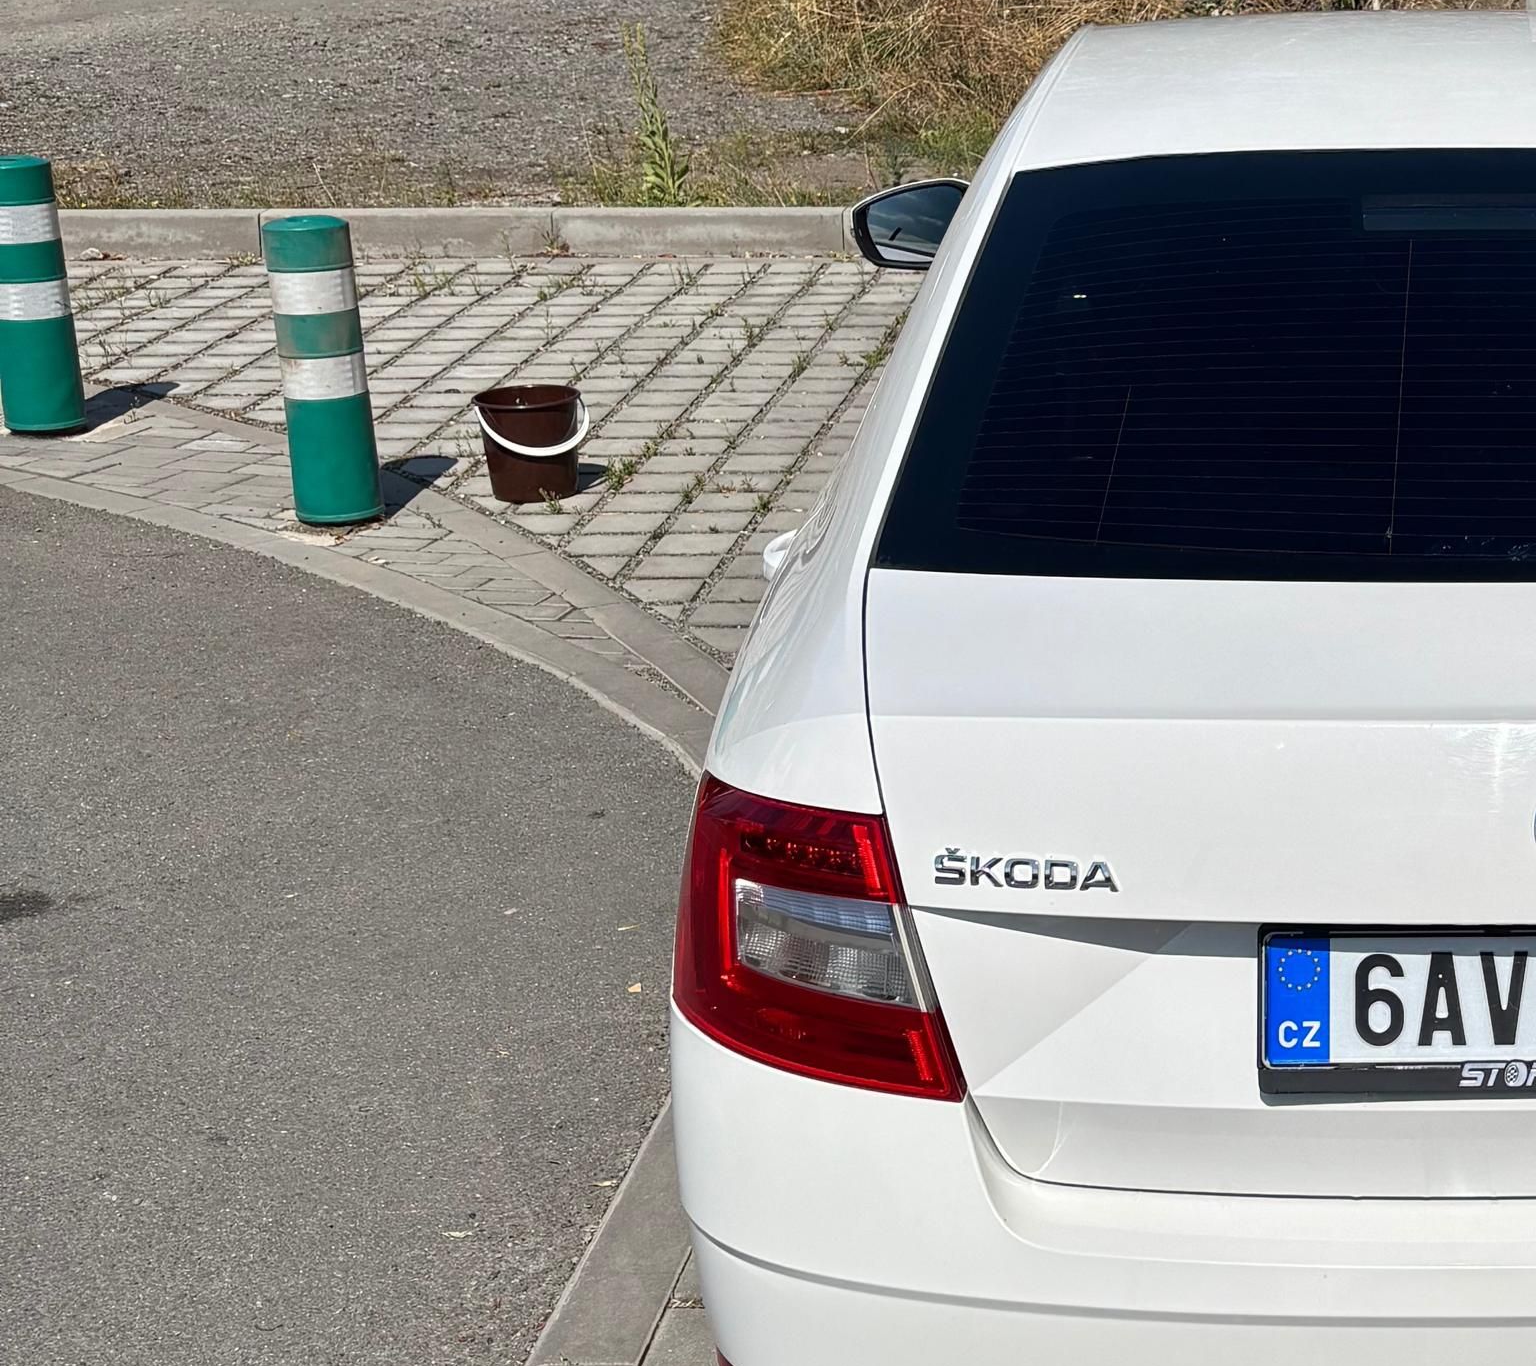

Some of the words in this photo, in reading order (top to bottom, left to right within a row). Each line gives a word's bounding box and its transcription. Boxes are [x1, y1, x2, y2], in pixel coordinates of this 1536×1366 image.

[934, 847, 1119, 893] ŠKODA
[1354, 950, 1532, 1047] 6AV
[1278, 1020, 1321, 1048] CZ
